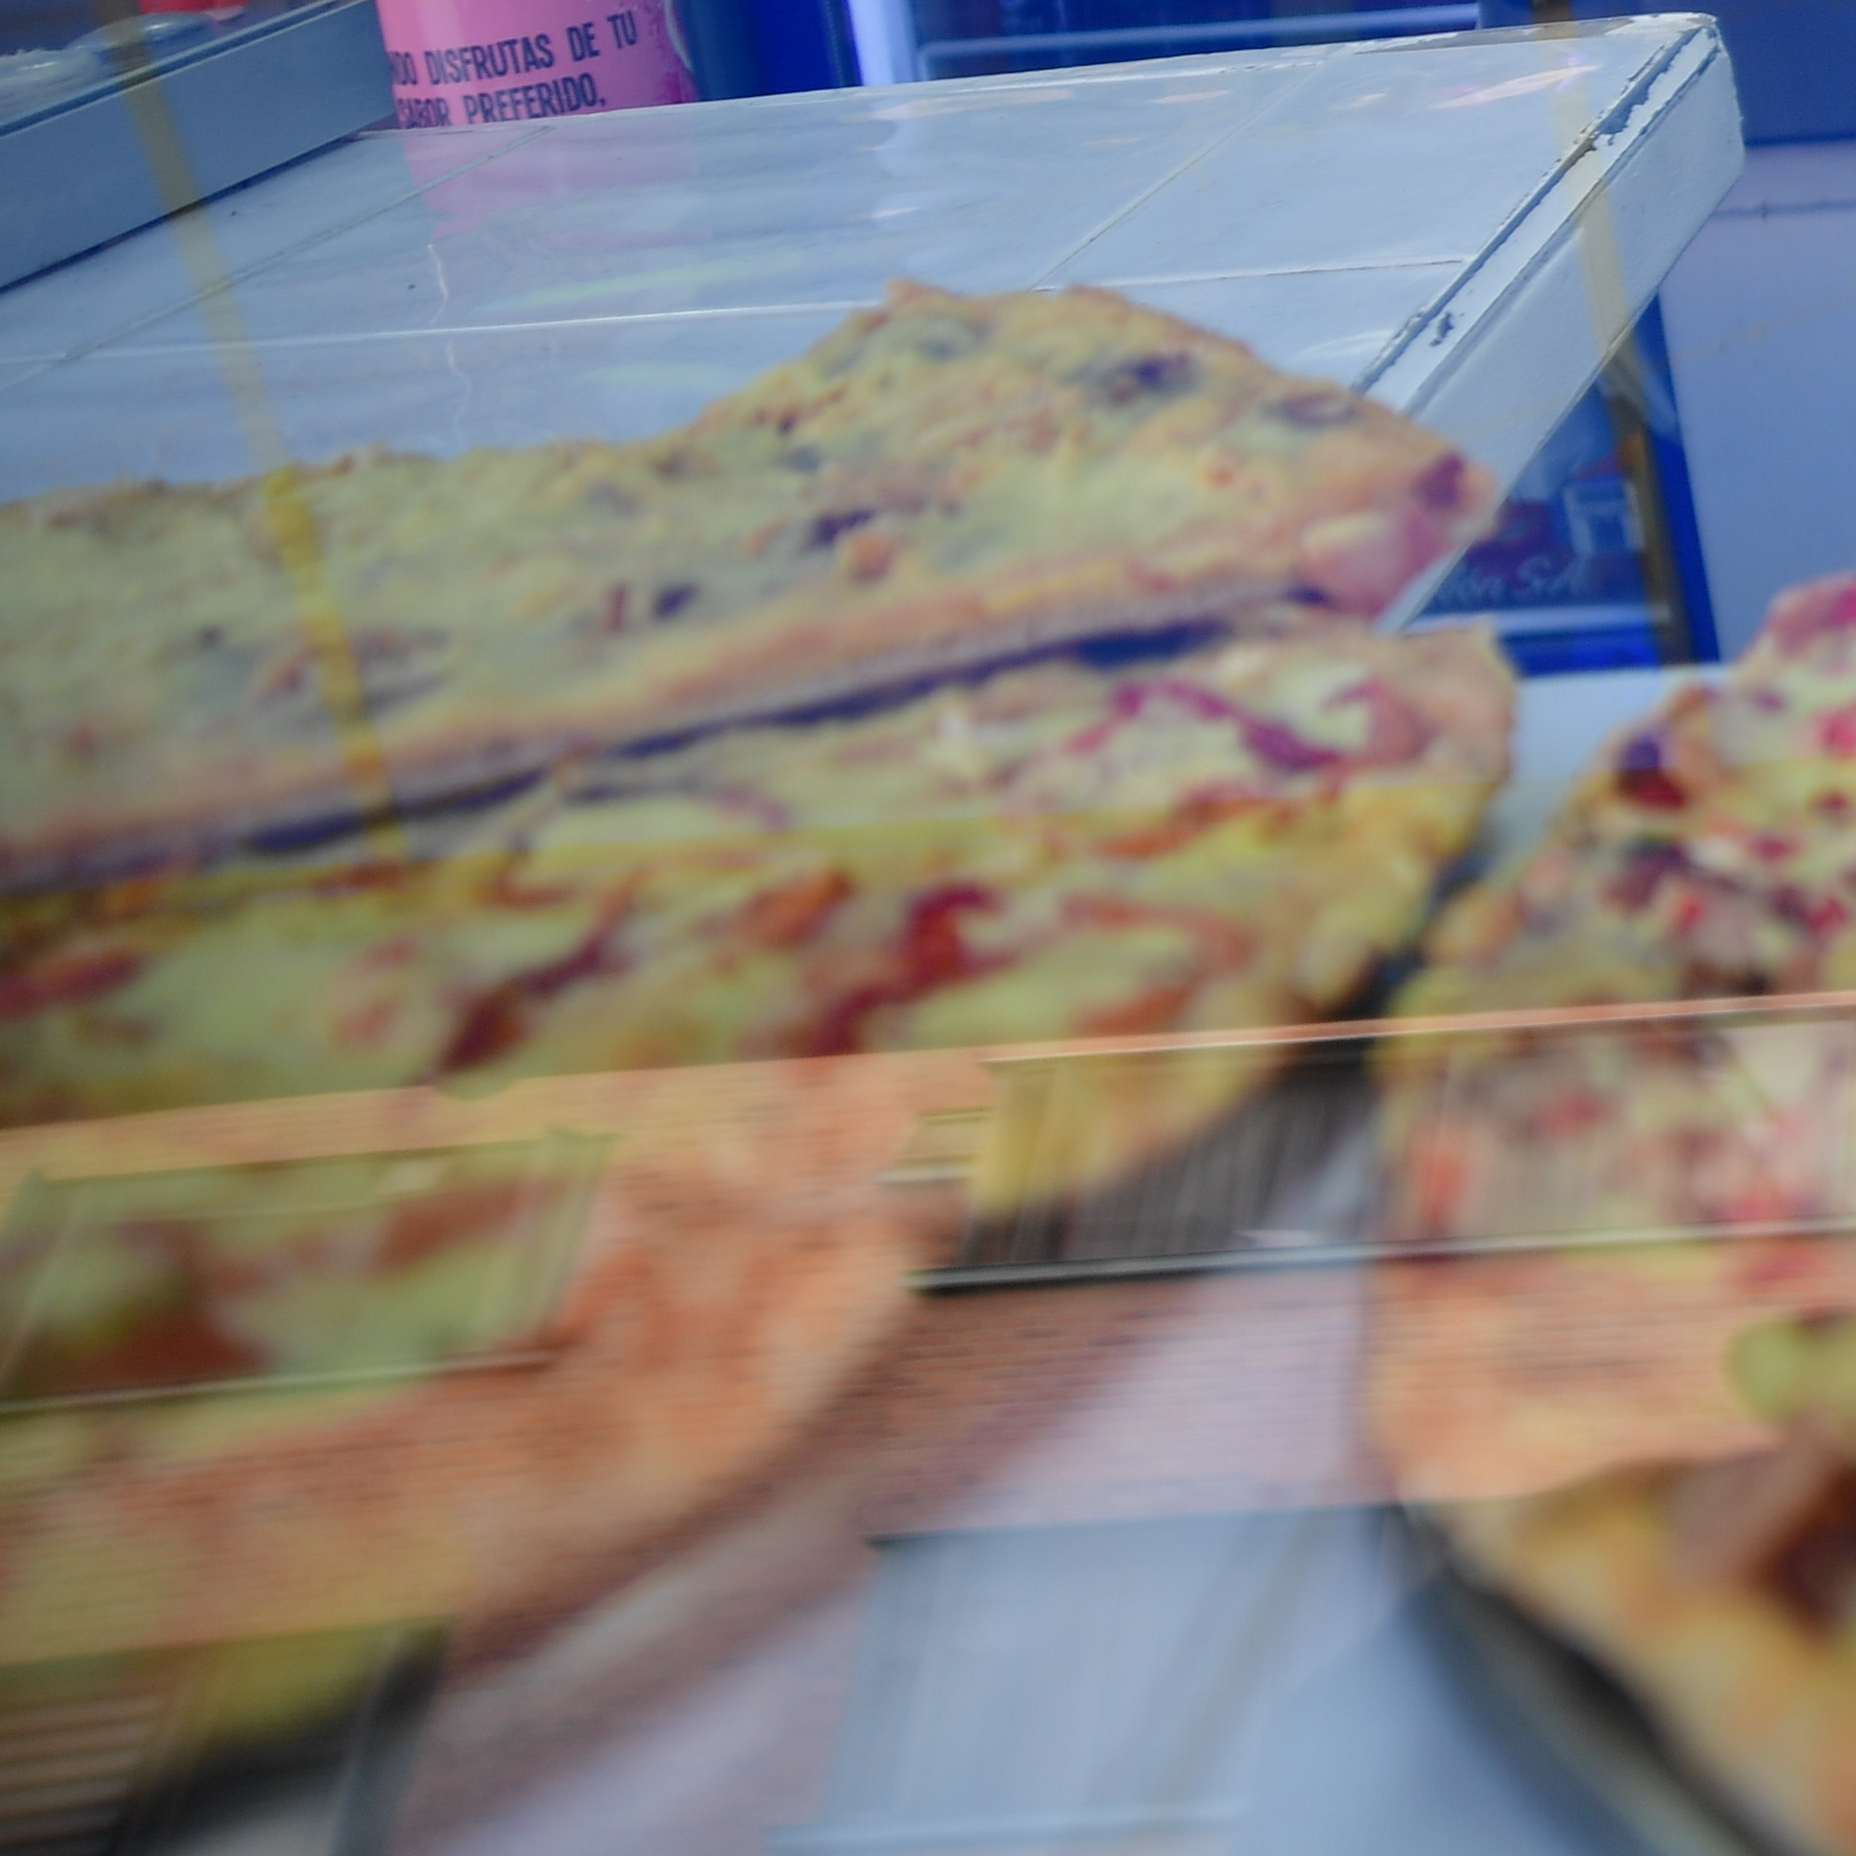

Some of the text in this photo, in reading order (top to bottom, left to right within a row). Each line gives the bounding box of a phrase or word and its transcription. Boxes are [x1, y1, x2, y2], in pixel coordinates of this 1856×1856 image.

[424, 33, 556, 85] DISFRUTAS
[566, 21, 600, 62] DE
[606, 9, 638, 50] TU
[462, 71, 607, 124] PREFERIDO,
